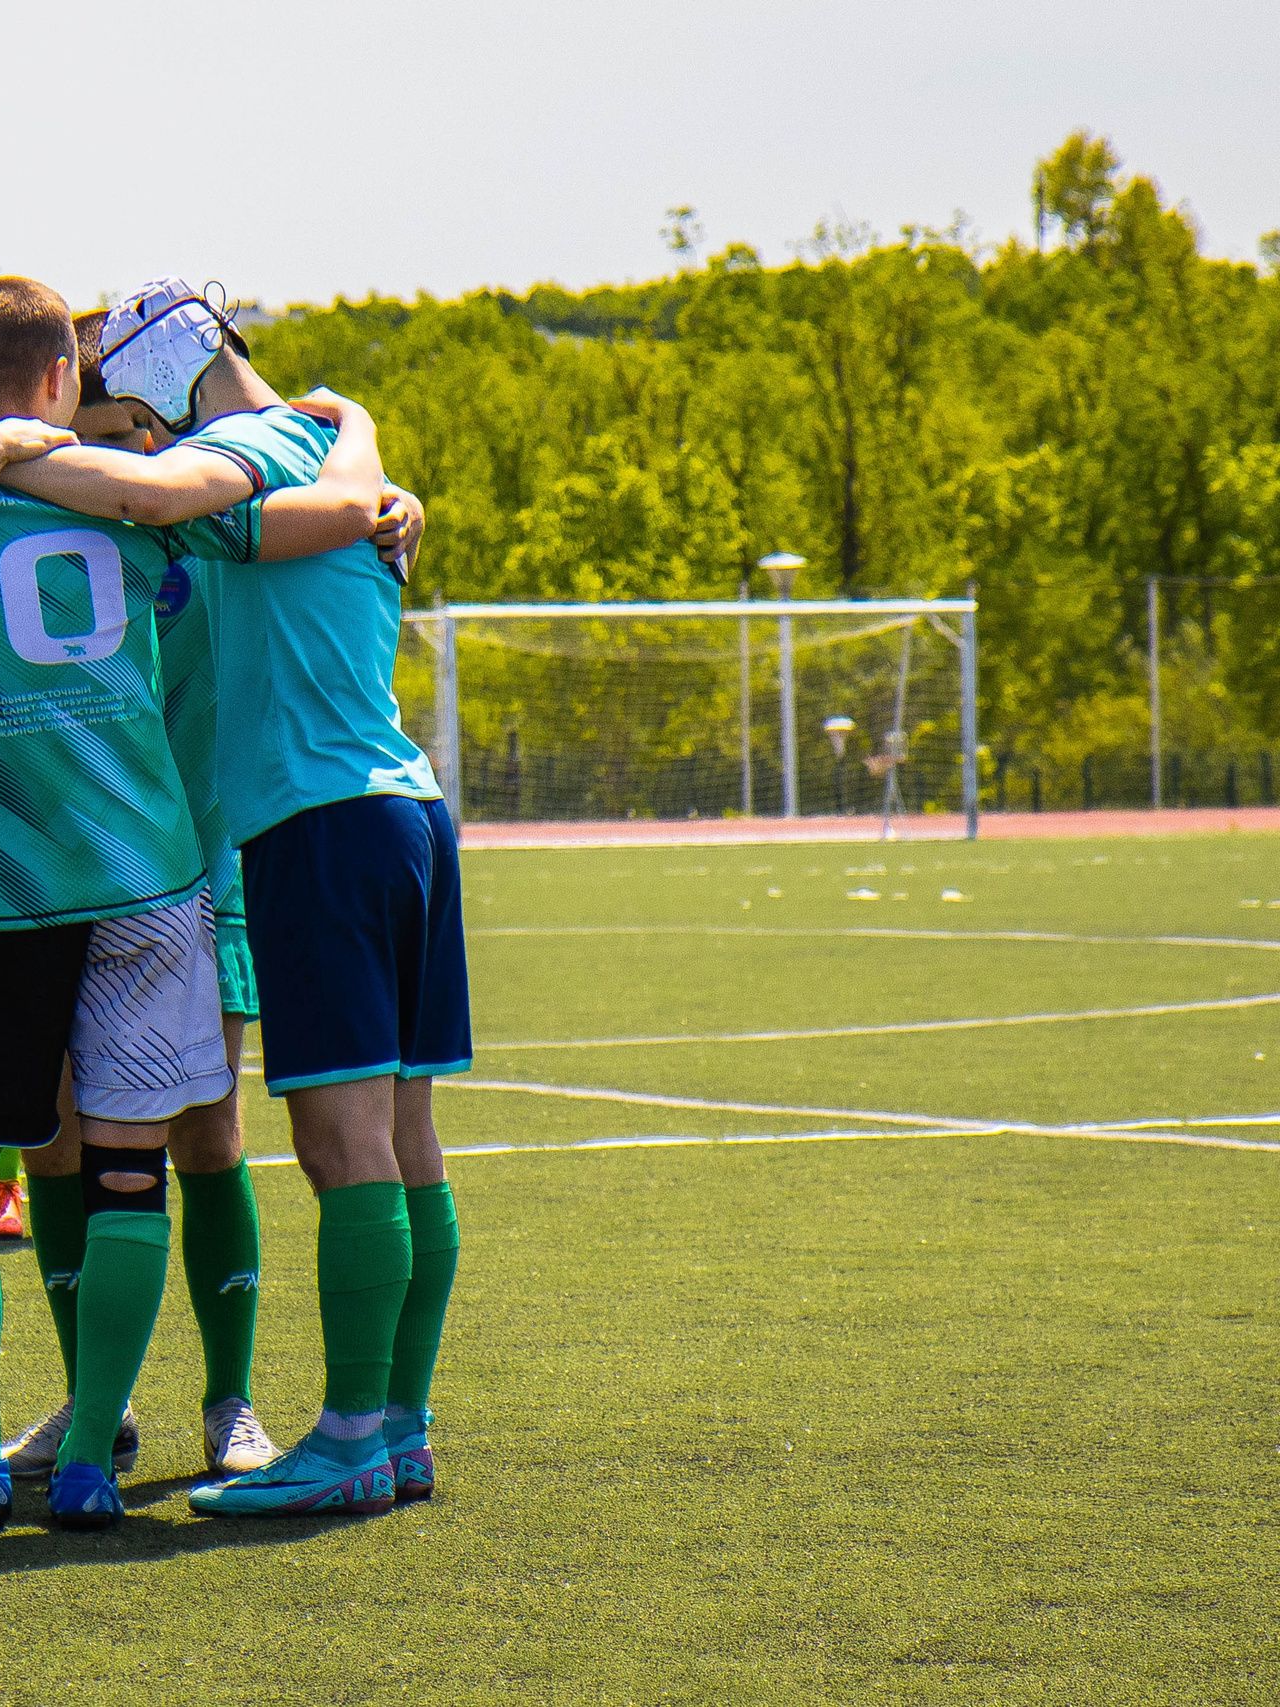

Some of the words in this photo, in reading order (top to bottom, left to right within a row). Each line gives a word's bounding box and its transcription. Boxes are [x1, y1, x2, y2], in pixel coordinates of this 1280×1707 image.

[3, 693, 122, 717] САНКТ-ПЕТЕРБУРГСКОГО
[89, 715, 110, 725] МЧС
[304, 1471, 395, 1512] AIR
